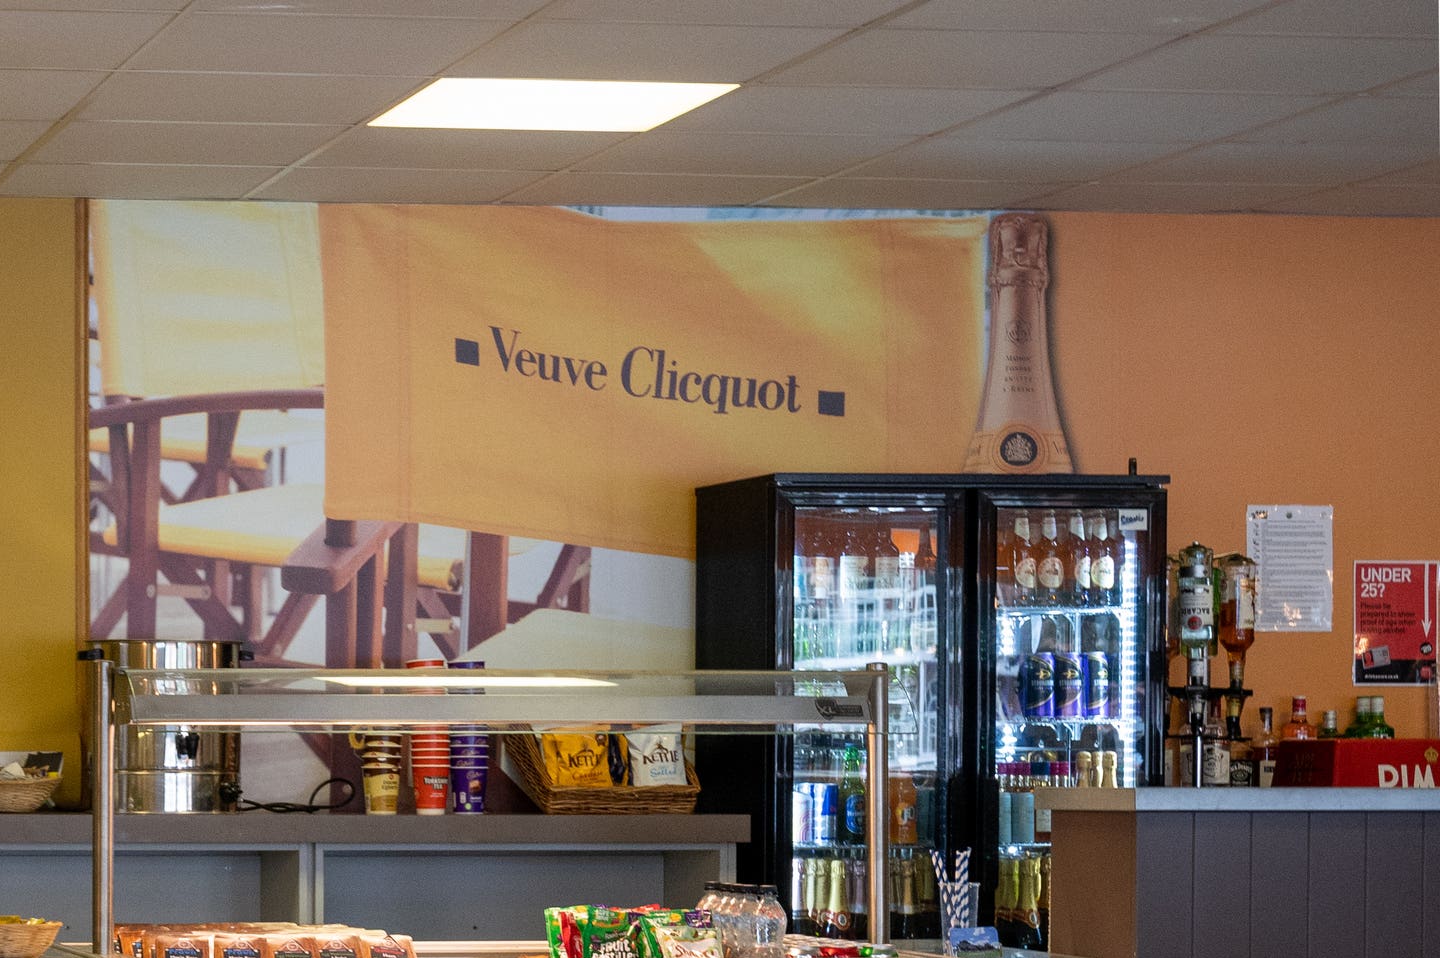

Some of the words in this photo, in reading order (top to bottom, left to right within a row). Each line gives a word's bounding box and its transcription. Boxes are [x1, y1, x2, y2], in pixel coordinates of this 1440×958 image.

[489, 325, 608, 391] Veuve
[620, 345, 802, 415] Clicquot
[1361, 567, 1412, 583] UNDER
[1360, 583, 1386, 598] 25?
[642, 749, 680, 765] KETTLE
